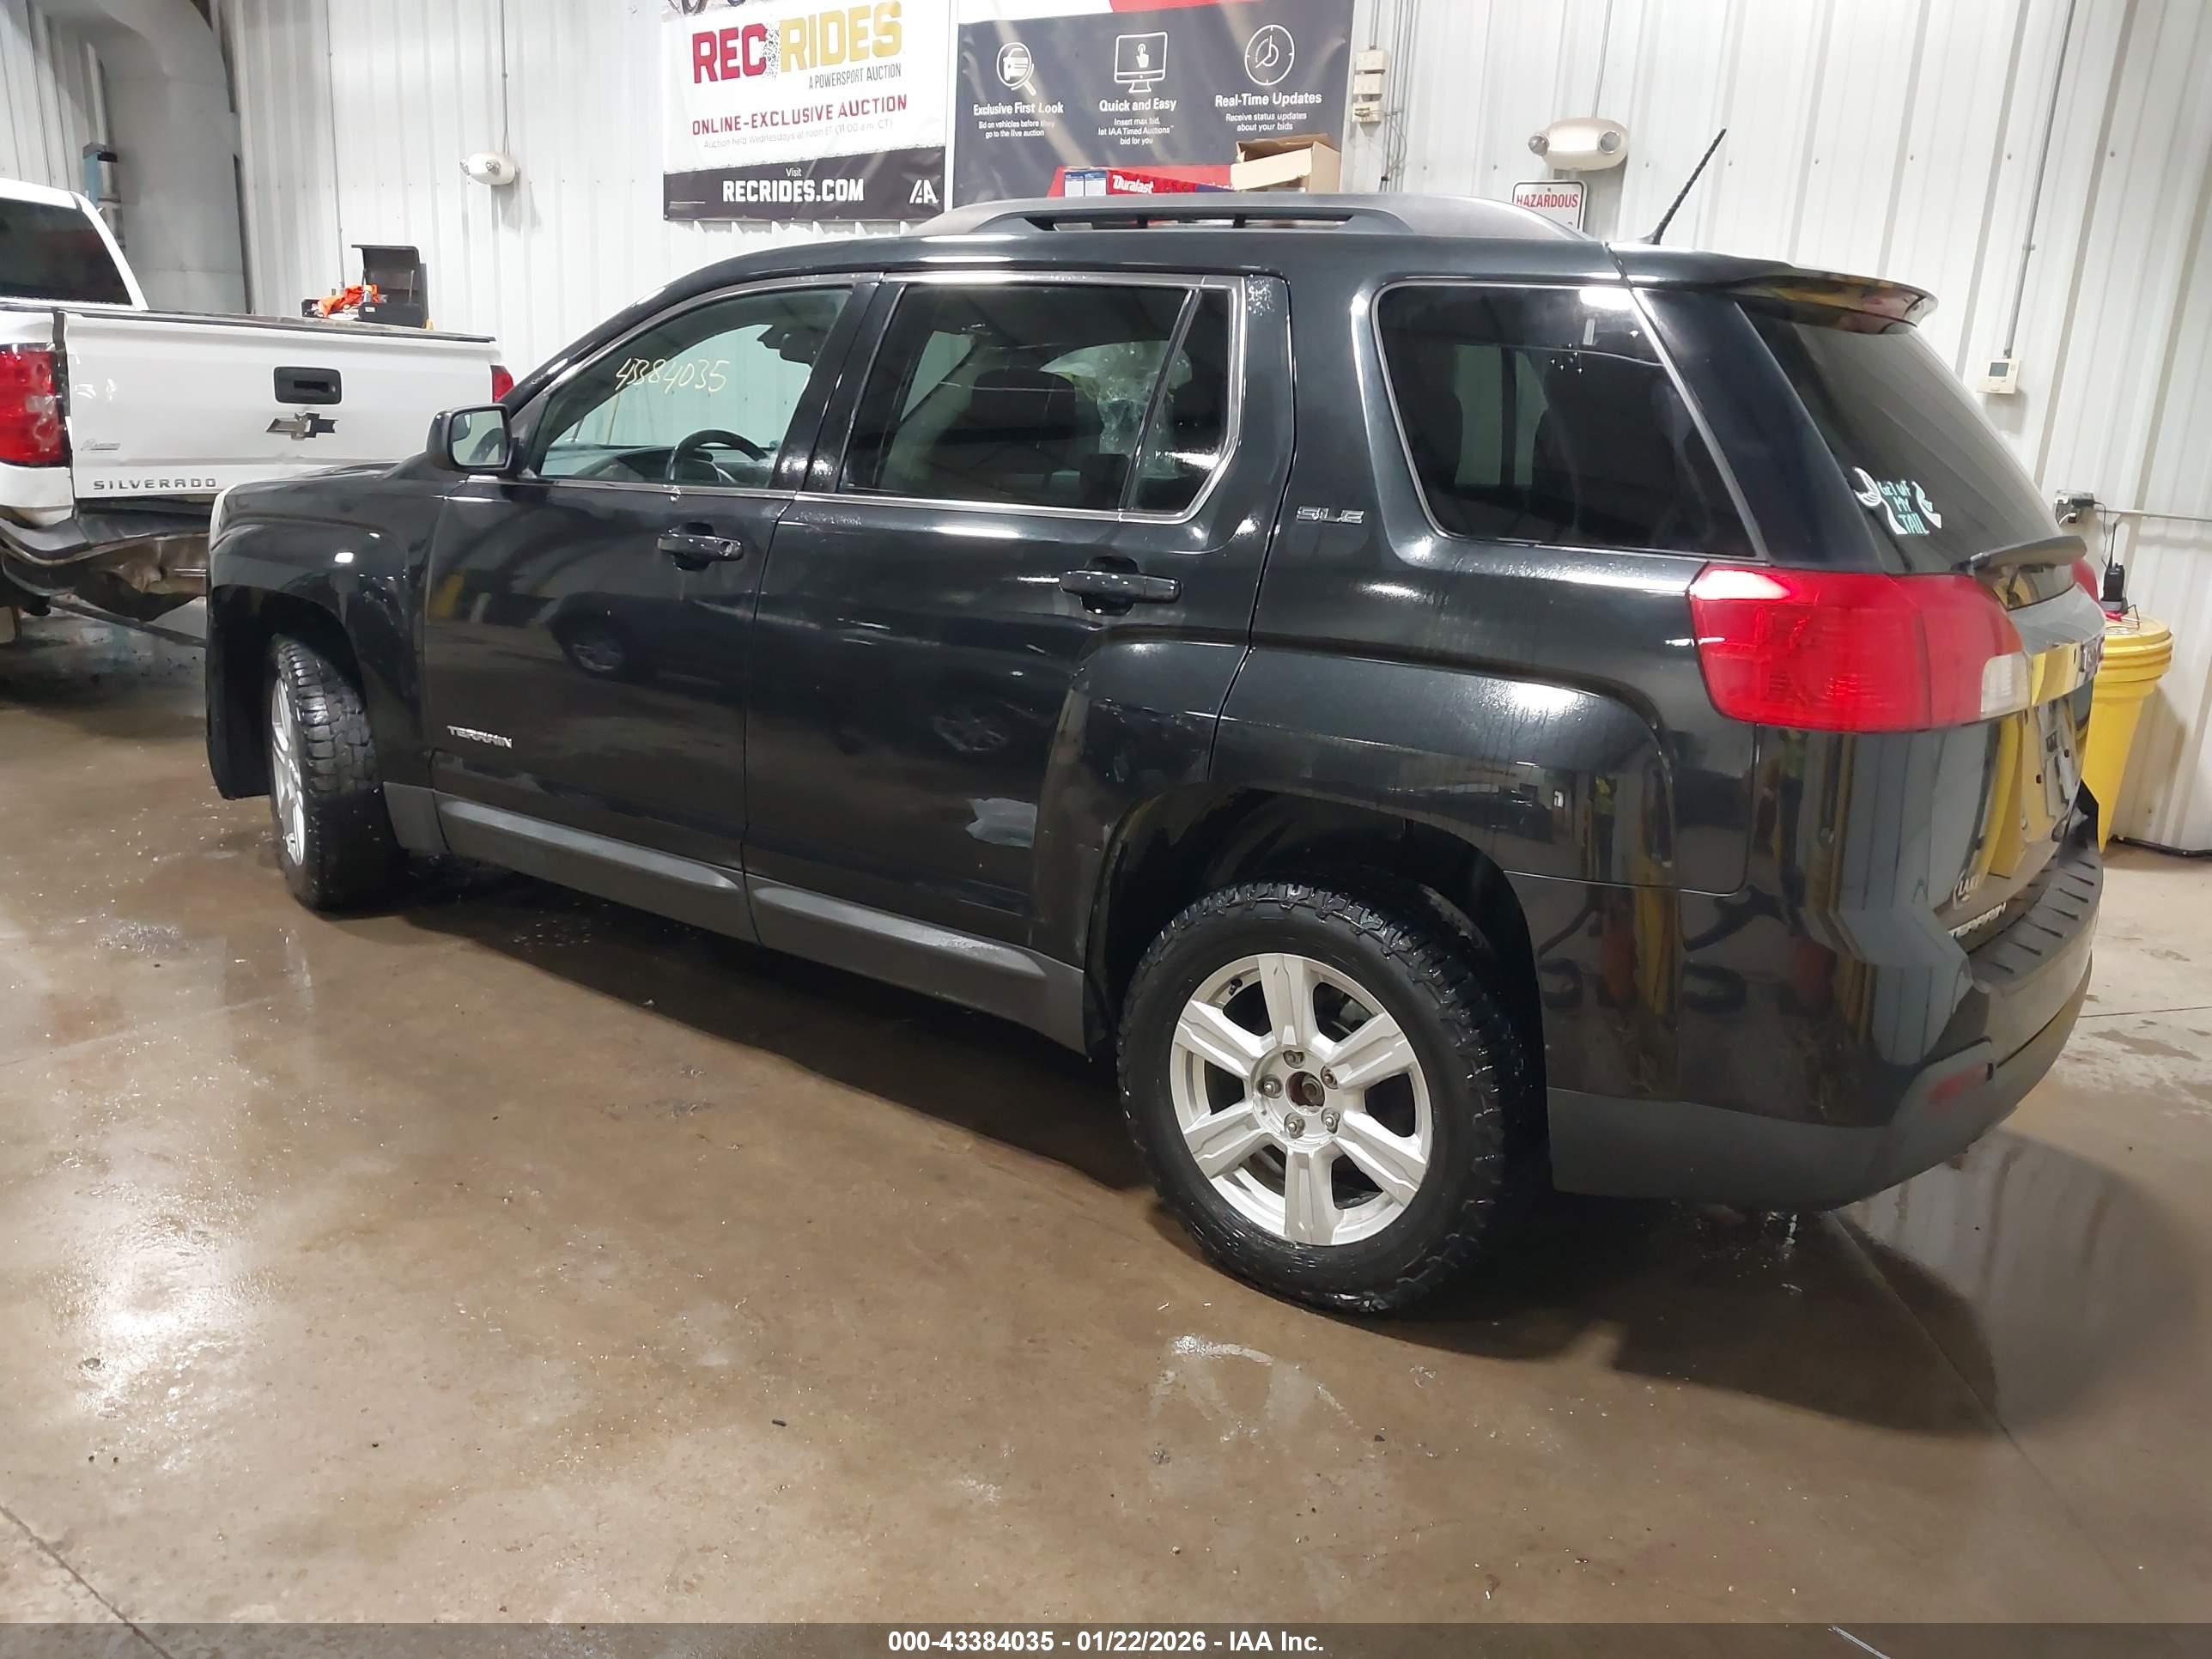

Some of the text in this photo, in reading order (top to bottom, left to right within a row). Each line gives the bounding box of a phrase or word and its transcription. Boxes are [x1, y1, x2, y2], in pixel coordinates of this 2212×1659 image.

[809, 63, 901, 89] A POWERSPORT AUCTION
[1099, 98, 1177, 112] Quick and Easy
[1215, 92, 1322, 106] Real-Time Updates
[692, 94, 907, 136] ONLINE-EXCLUSIVE AUCTION
[973, 100, 1064, 116] Exclusive First Look
[1226, 112, 1307, 122] Receive status updates
[1237, 122, 1293, 132] about your bids
[786, 167, 802, 177] Visit
[723, 179, 865, 202] RECRIDES.COM
[1112, 174, 1154, 194] Duralast
[1516, 193, 1579, 208] HAZARDOUS
[615, 357, 730, 395] 43384035
[94, 477, 216, 490] SILVERADO
[1297, 506, 1364, 524] SLE
